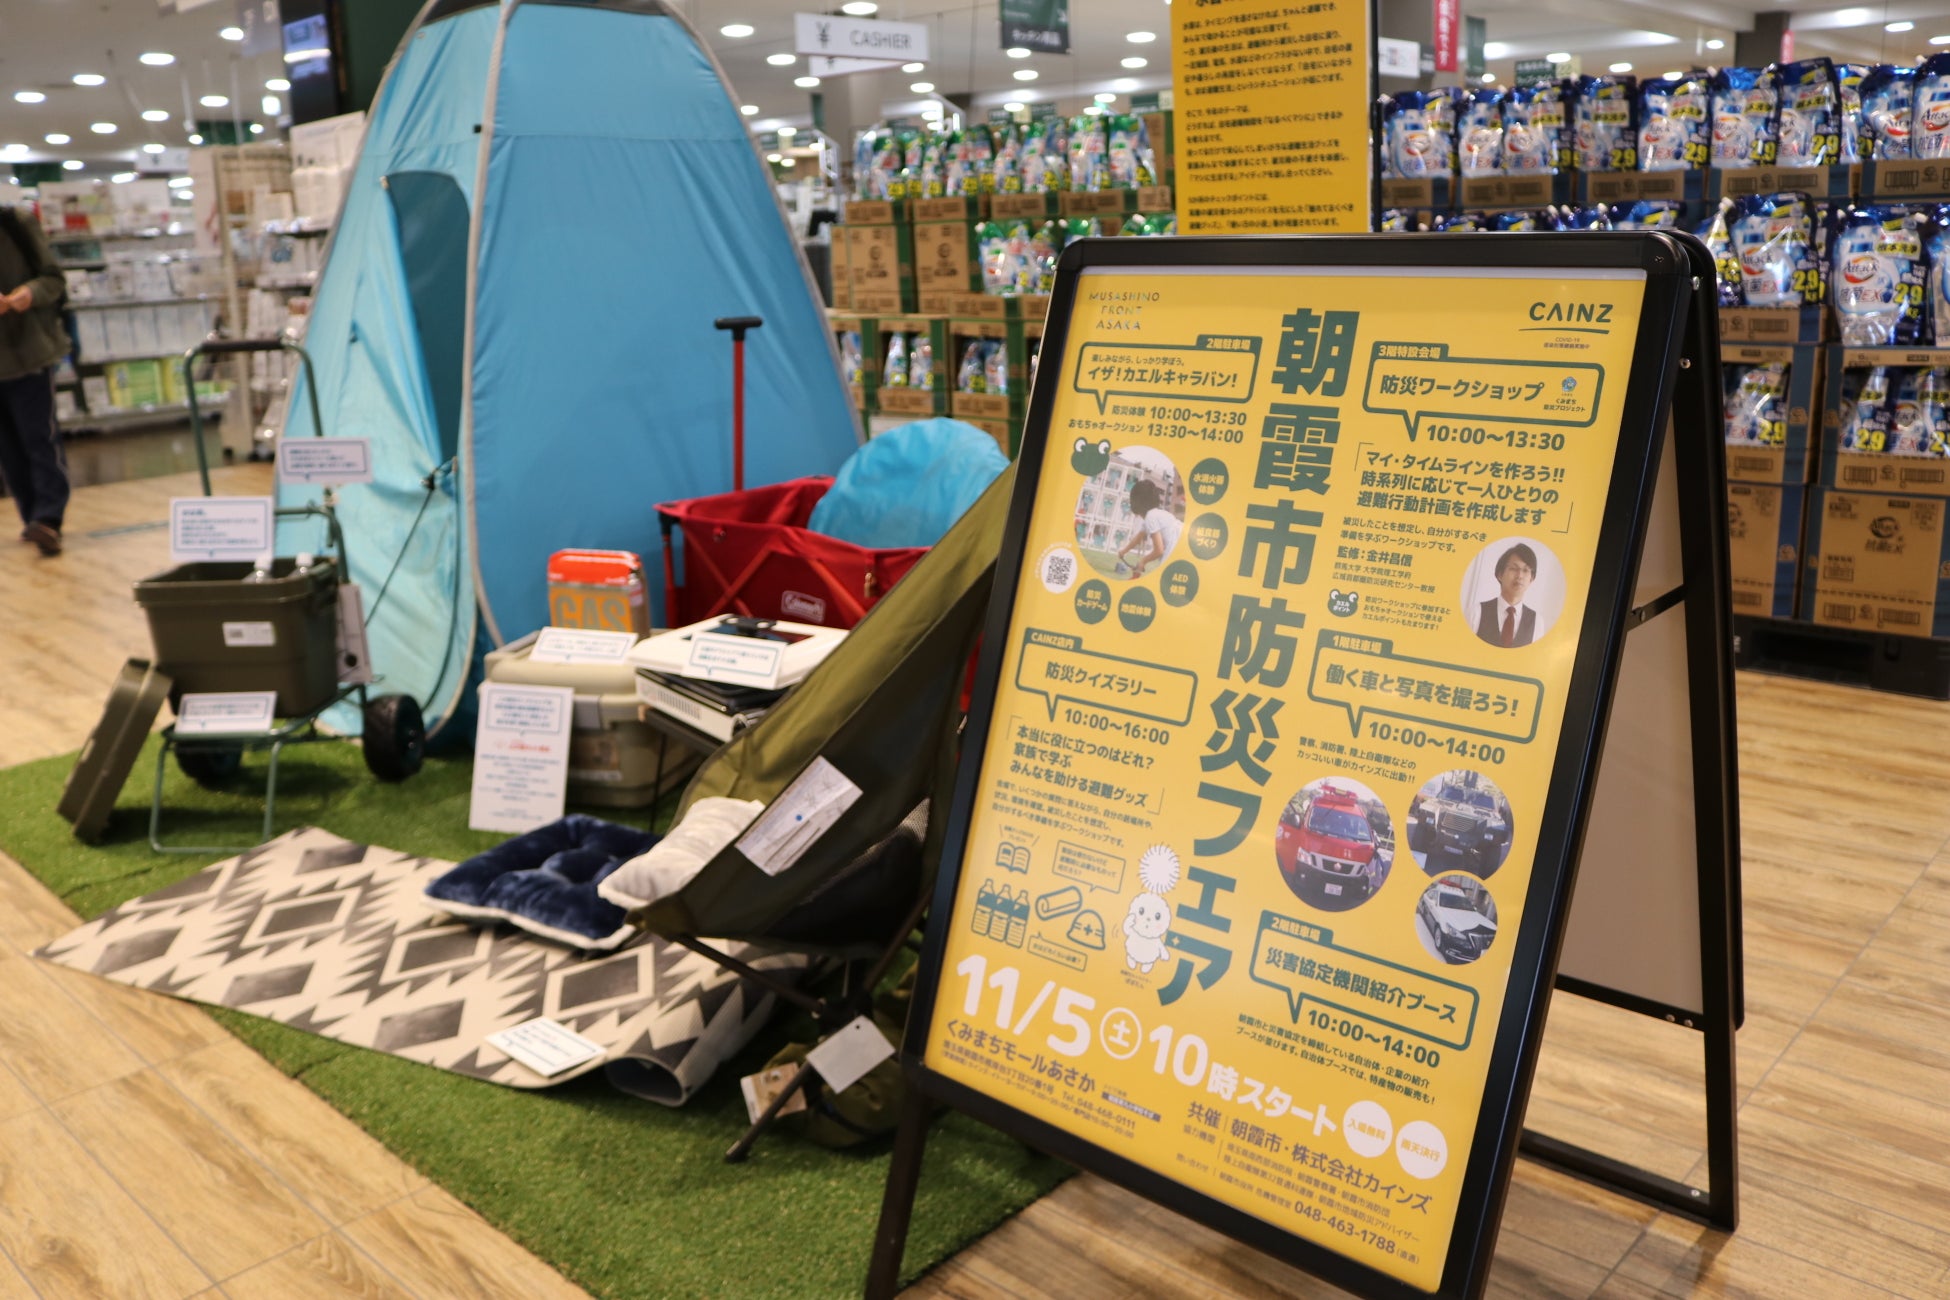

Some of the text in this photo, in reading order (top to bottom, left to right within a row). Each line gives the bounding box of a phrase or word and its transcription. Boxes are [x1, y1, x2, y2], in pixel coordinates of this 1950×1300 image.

[851, 29, 913, 49] CASHIER
[1088, 291, 1161, 302] MUSASHINO
[1101, 305, 1143, 315] FRONT
[1529, 302, 1614, 324] CAINZ
[1095, 320, 1142, 331] ASAKA
[1379, 373, 1545, 402] 防災ワークショップ
[1360, 469, 1560, 505] 時系列に応じて一人ひとりの
[1356, 489, 1547, 526] 避難行動計画を作成します
[1172, 573, 1189, 583] AED
[1045, 660, 1158, 697] 防災クイズラリー
[1013, 741, 1073, 769] 家族で学ぶ
[1009, 759, 1149, 808] みんなを助ける避難グッズ
[1265, 946, 1458, 1025] 災害協定機関紹介ブース
[946, 1018, 1097, 1094] くみまちモールあさか
[956, 953, 1097, 1057] 11/5
[1149, 1024, 1338, 1137] 10時スタート
[1186, 1101, 1223, 1130] 共催
[1230, 1118, 1434, 1215] 朝霞市・株式会社カインズ
[1293, 1199, 1397, 1255] 048-463-1788
